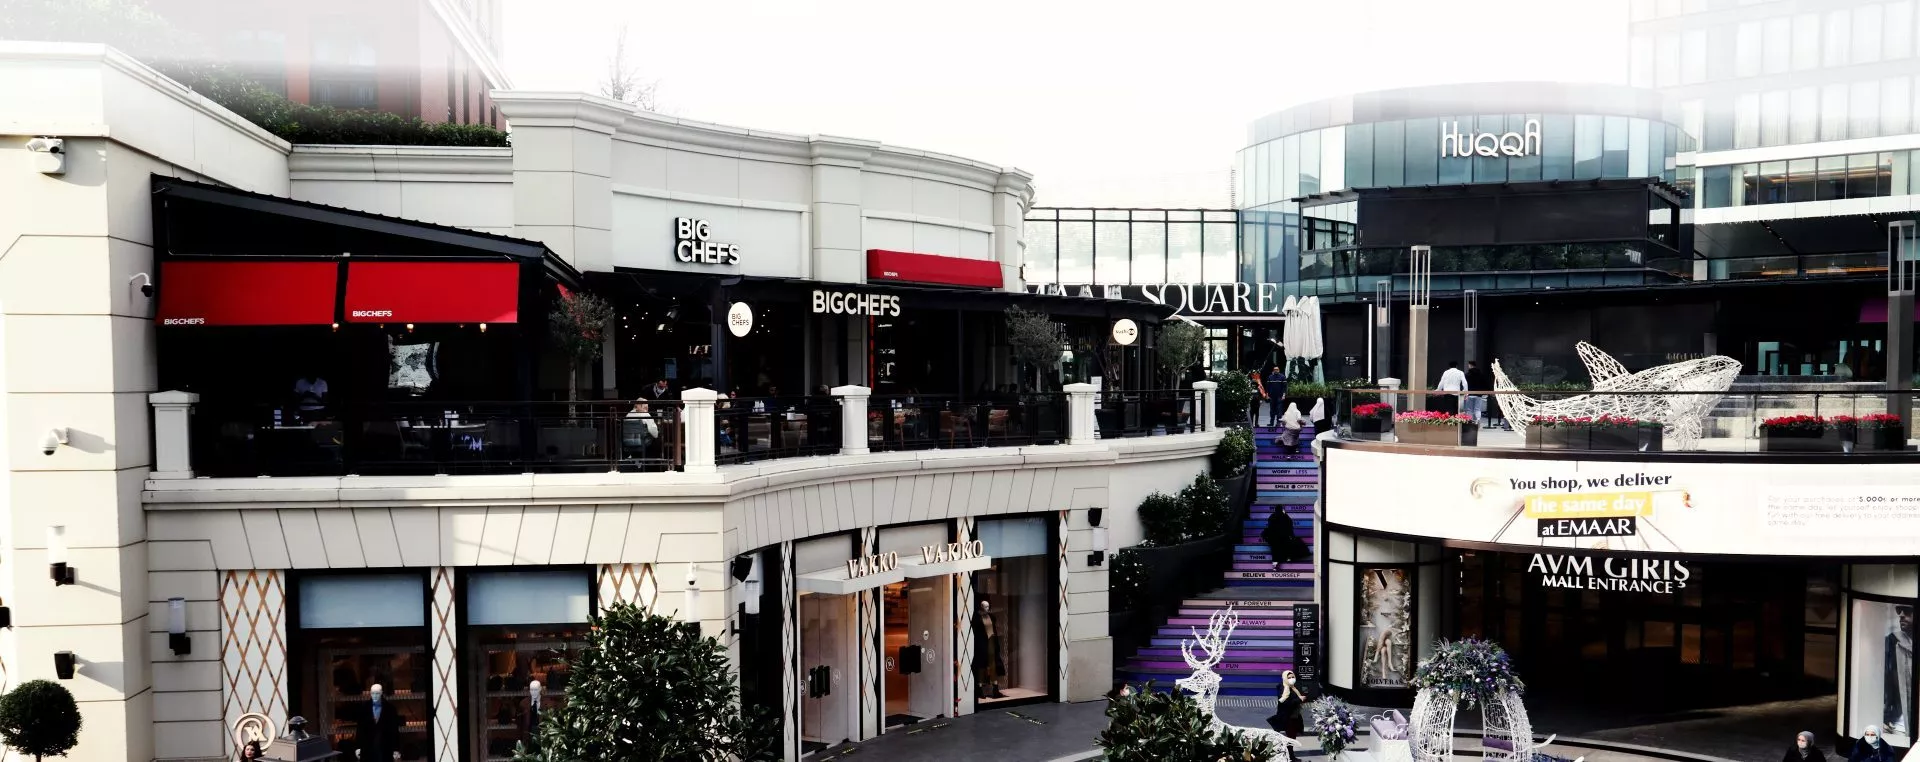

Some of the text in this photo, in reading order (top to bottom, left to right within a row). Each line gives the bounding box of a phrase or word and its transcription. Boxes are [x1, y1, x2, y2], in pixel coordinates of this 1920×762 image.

[678, 217, 711, 241] BIG
[677, 240, 741, 265] CHEFS
[812, 290, 901, 317] BIGCHEFS
[1141, 282, 1278, 319] SQUARE
[1509, 472, 1673, 493] You shop, we deliver
[1531, 494, 1645, 514] the same day
[1541, 518, 1633, 536] at EMAAR
[921, 539, 984, 565] VAKKO
[847, 550, 898, 580] VAKKO
[1527, 553, 1594, 577] AVM
[1542, 574, 1673, 595] MALL ENTRANCE
